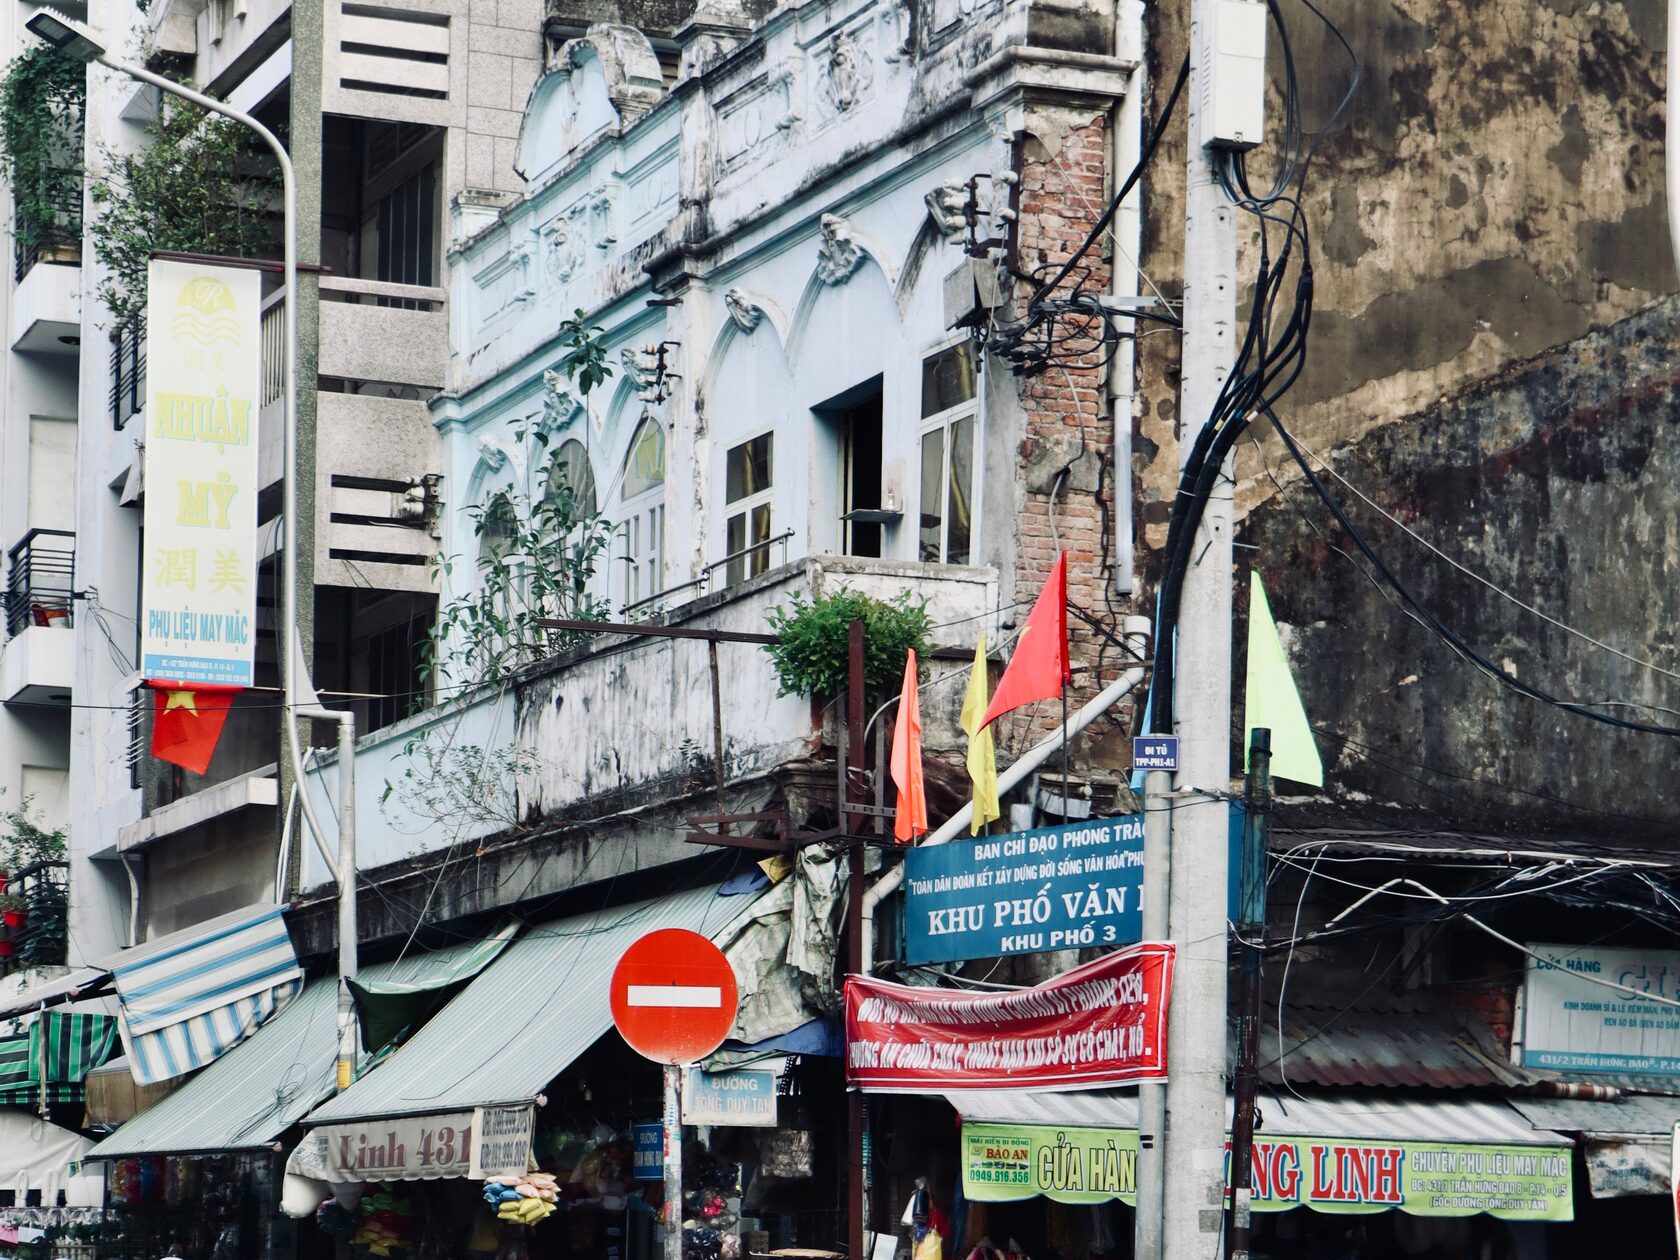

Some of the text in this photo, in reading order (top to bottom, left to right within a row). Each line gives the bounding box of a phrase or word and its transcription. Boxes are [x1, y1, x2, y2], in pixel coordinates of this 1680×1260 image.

[154, 547, 248, 594] 潤美
[148, 605, 249, 653] PHỤ LIỆU MAY MẶC
[974, 842, 1001, 861] BAN
[1003, 833, 1027, 857] CHỈ
[1029, 834, 1058, 856] ĐẠO
[1063, 827, 1111, 849] PHONG
[934, 874, 952, 893] DÂN
[953, 870, 975, 890] ĐOÀN
[976, 865, 993, 887] KẾT
[995, 866, 1012, 885] XÂY
[1014, 864, 1038, 885] DỰNG
[1039, 859, 1056, 879] ĐỜI
[1057, 853, 1083, 877] SỐNG
[1084, 854, 1104, 873] VĂN
[928, 904, 985, 936] KHU
[993, 882, 1052, 928] PHỐ
[1061, 882, 1128, 919] VĂN
[1001, 920, 1117, 952] KHU PHỐ 3
[1566, 957, 1601, 973] HÀNG
[880, 1037, 901, 1069] ÁN
[897, 1037, 932, 1069] CHỮA
[964, 1036, 1001, 1070] THOÁT
[999, 1039, 1026, 1075] NẠN
[1025, 1037, 1047, 1067] KHI
[1045, 1030, 1061, 1066] CÓ
[1062, 1031, 1081, 1071] SỰ
[1079, 1021, 1097, 1064] CỐ
[1096, 1022, 1127, 1062] CHÁY,
[1539, 1054, 1569, 1065] 431/2
[1571, 1053, 1598, 1067] TRẦN
[711, 1075, 759, 1092] ĐƯỜNG
[727, 1097, 748, 1113] DUY
[338, 1131, 407, 1172] Linh
[416, 1126, 472, 1170] 431
[1012, 1149, 1029, 1160] AN
[1037, 1131, 1139, 1194] CỬA HÀN
[1411, 1147, 1457, 1173] CHUYÊN
[1459, 1153, 1483, 1179] PHỤ
[1486, 1150, 1510, 1179] LIỆU
[1513, 1155, 1538, 1176] MAY
[1541, 1152, 1568, 1182] MẶC
[970, 1169, 1029, 1183] 0949.916.356
[1309, 1145, 1405, 1205] LINH
[1450, 1176, 1473, 1193] TRẦN
[1474, 1179, 1497, 1194] HƯNG
[1499, 1182, 1515, 1197] ĐẠO
[1429, 1194, 1450, 1209] (GÓC
[1452, 1195, 1483, 1209] ĐƯỜNG
[1508, 1199, 1525, 1210] DUY
